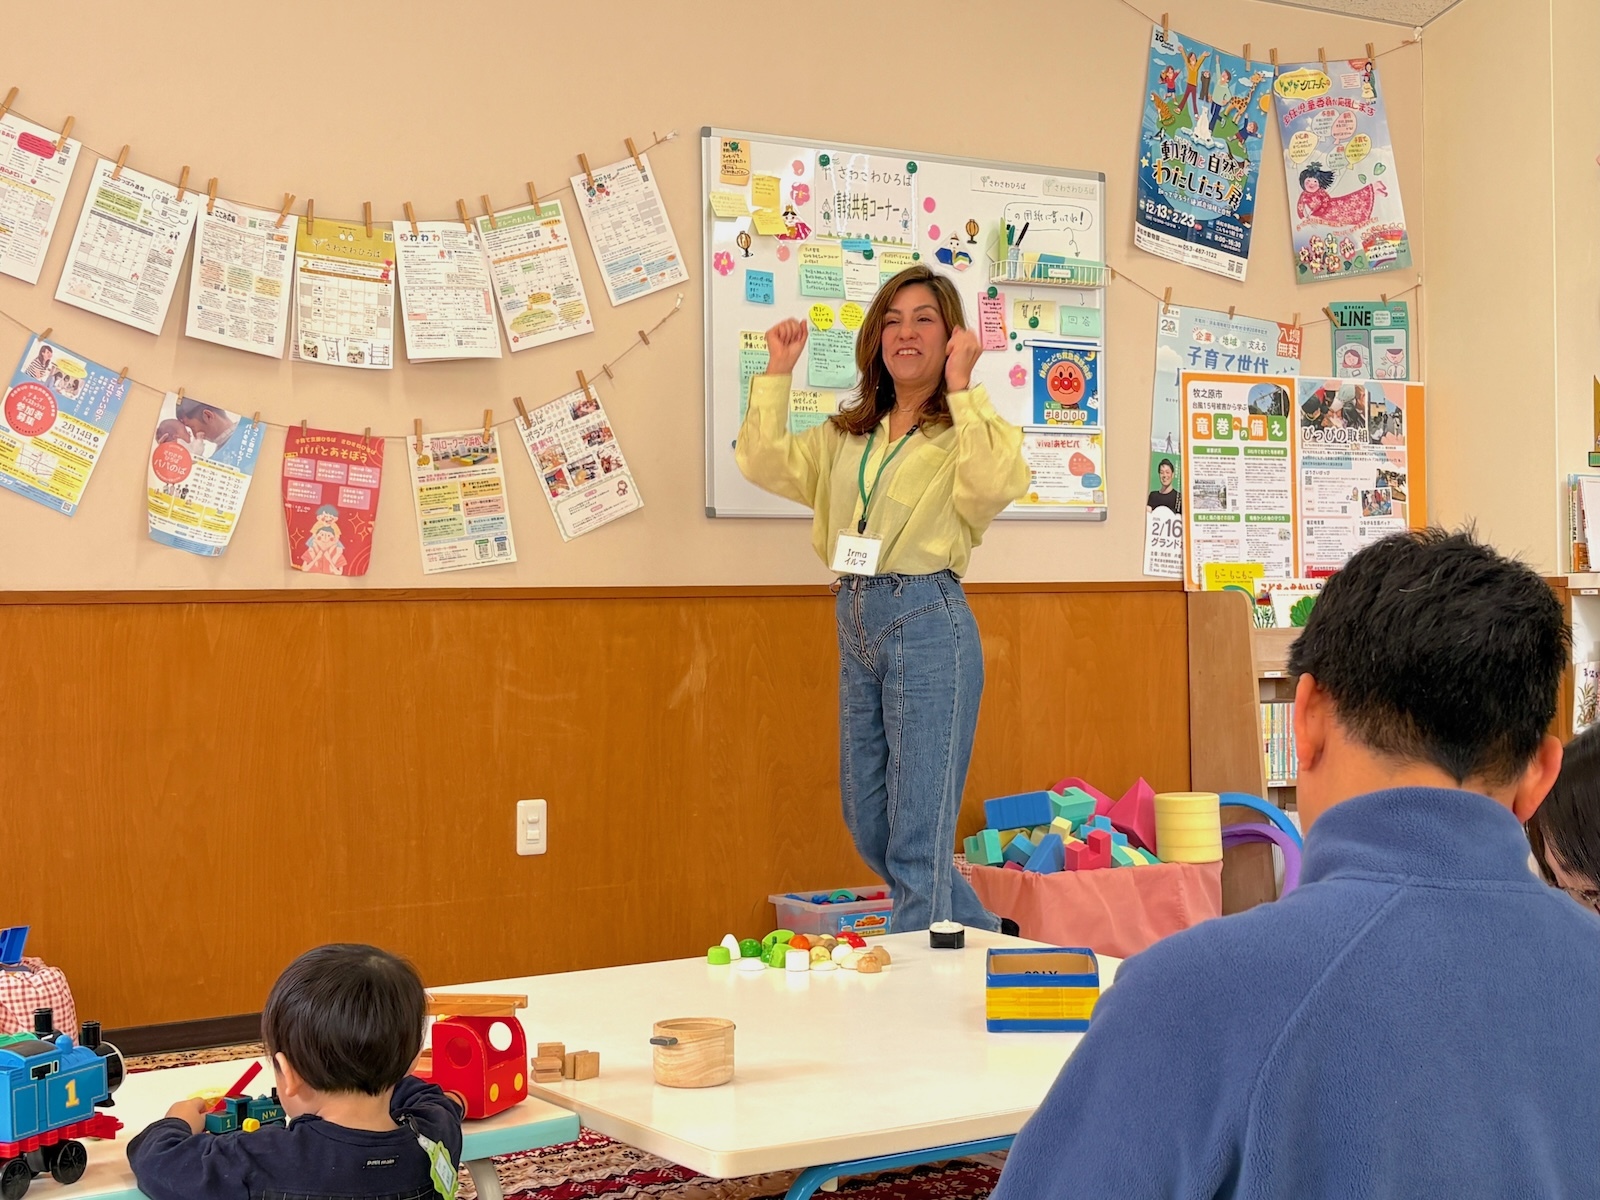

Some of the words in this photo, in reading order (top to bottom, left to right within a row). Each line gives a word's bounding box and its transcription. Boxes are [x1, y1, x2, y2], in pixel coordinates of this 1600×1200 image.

[1161, 140, 1244, 181] 動物と自然と
[989, 180, 1026, 190] さわさわひろば
[1054, 184, 1094, 195] さわさわひろば
[1152, 159, 1243, 211] わたしたち展
[1145, 202, 1168, 219] 12/13
[1172, 211, 1195, 228] 2/23
[326, 243, 380, 258] さわさわひろば
[303, 259, 309, 268] 2
[1022, 303, 1042, 319] 質問
[1340, 311, 1371, 327] LINE
[1068, 315, 1090, 327] 回答
[1195, 331, 1212, 343] 企業
[1222, 335, 1237, 347] 地域
[1248, 340, 1267, 352] 支える
[1279, 328, 1300, 344] 入場
[1277, 343, 1299, 359] 無料
[1187, 345, 1269, 375] 子育て世代
[1193, 389, 1223, 399] 牧之原市
[16, 401, 44, 421] 参加者
[1046, 410, 1086, 419] #8000
[1192, 402, 1248, 411] 台風15号被害から学ぶ
[61, 421, 92, 440] 2月14日
[1195, 417, 1283, 438] 竜巻への備え
[1303, 427, 1369, 443] ぴっぴの取組
[299, 444, 368, 464] パパとあそぼう
[154, 458, 188, 475] パパのば
[1152, 518, 1183, 538] 2/16
[847, 548, 868, 559] Irma
[844, 557, 867, 567] イルマ
[65, 1079, 80, 1109] 1
[262, 1109, 278, 1121] NW
[225, 1118, 232, 1130] 1
